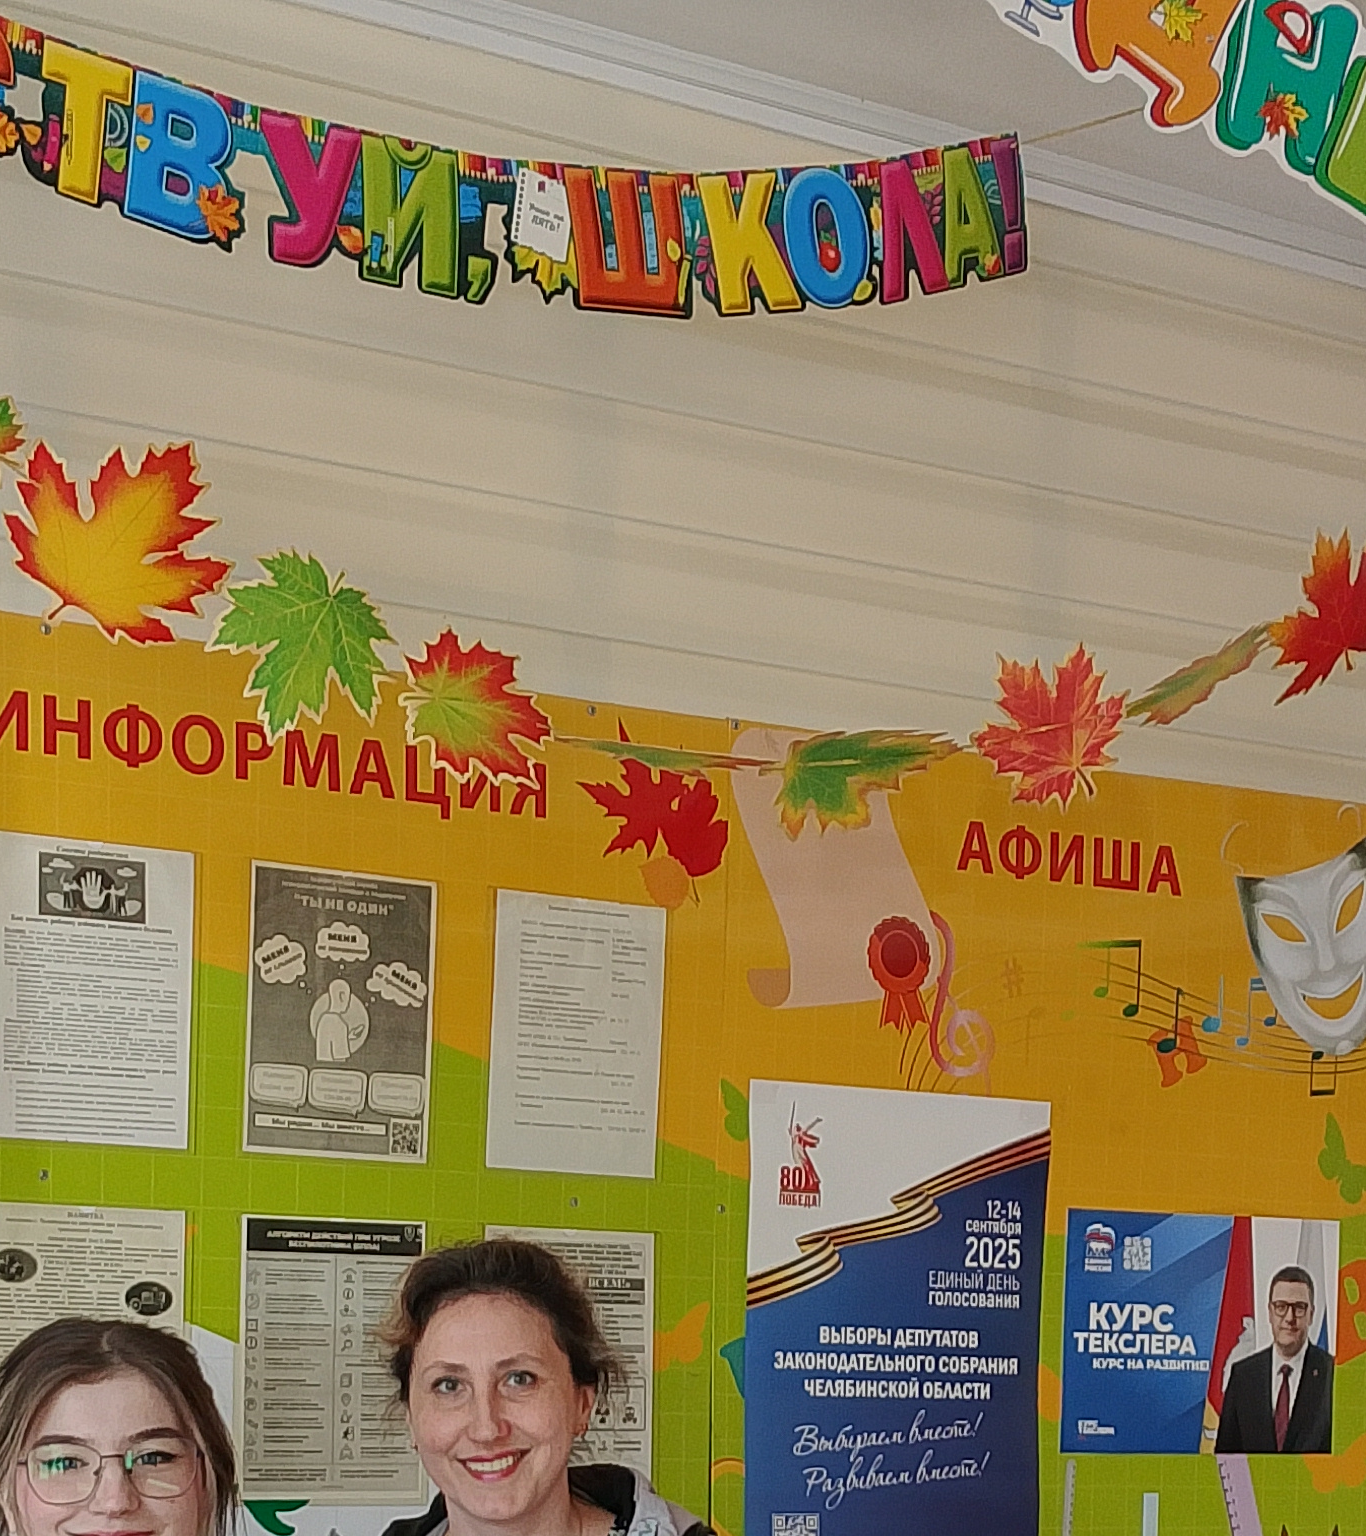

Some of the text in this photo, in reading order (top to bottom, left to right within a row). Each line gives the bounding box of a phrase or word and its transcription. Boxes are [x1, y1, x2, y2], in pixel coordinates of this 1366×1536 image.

[563, 132, 1030, 318] ШКОЛА!
[956, 820, 1183, 897] АФИША
[780, 1165, 803, 1190] 80
[985, 1199, 1022, 1220] 12-14
[965, 1218, 1022, 1238] сентября
[964, 1237, 1021, 1270] 2025
[928, 1269, 1021, 1293] ЕДИНЫЙ ДЕНЬ
[928, 1290, 1021, 1310] голосования
[1088, 1302, 1175, 1332] КУРС
[819, 1325, 979, 1349] ВЫБОРЫ ДЕПУТАТОВ
[1073, 1331, 1197, 1356] ТЕКСЛЕРА
[773, 1351, 1019, 1376] ЗАКОНОДАТЕЛЬНОГО СОБРАНИЯ
[1092, 1357, 1125, 1370] КУРС
[1126, 1359, 1145, 1370] НА
[803, 1376, 991, 1400] ЧЕЛЯБИНСКОЙ ОБЛАСТИ
[792, 1408, 984, 1462] Выбираем вместе!
[802, 1449, 991, 1511] Развиваем вместе!
